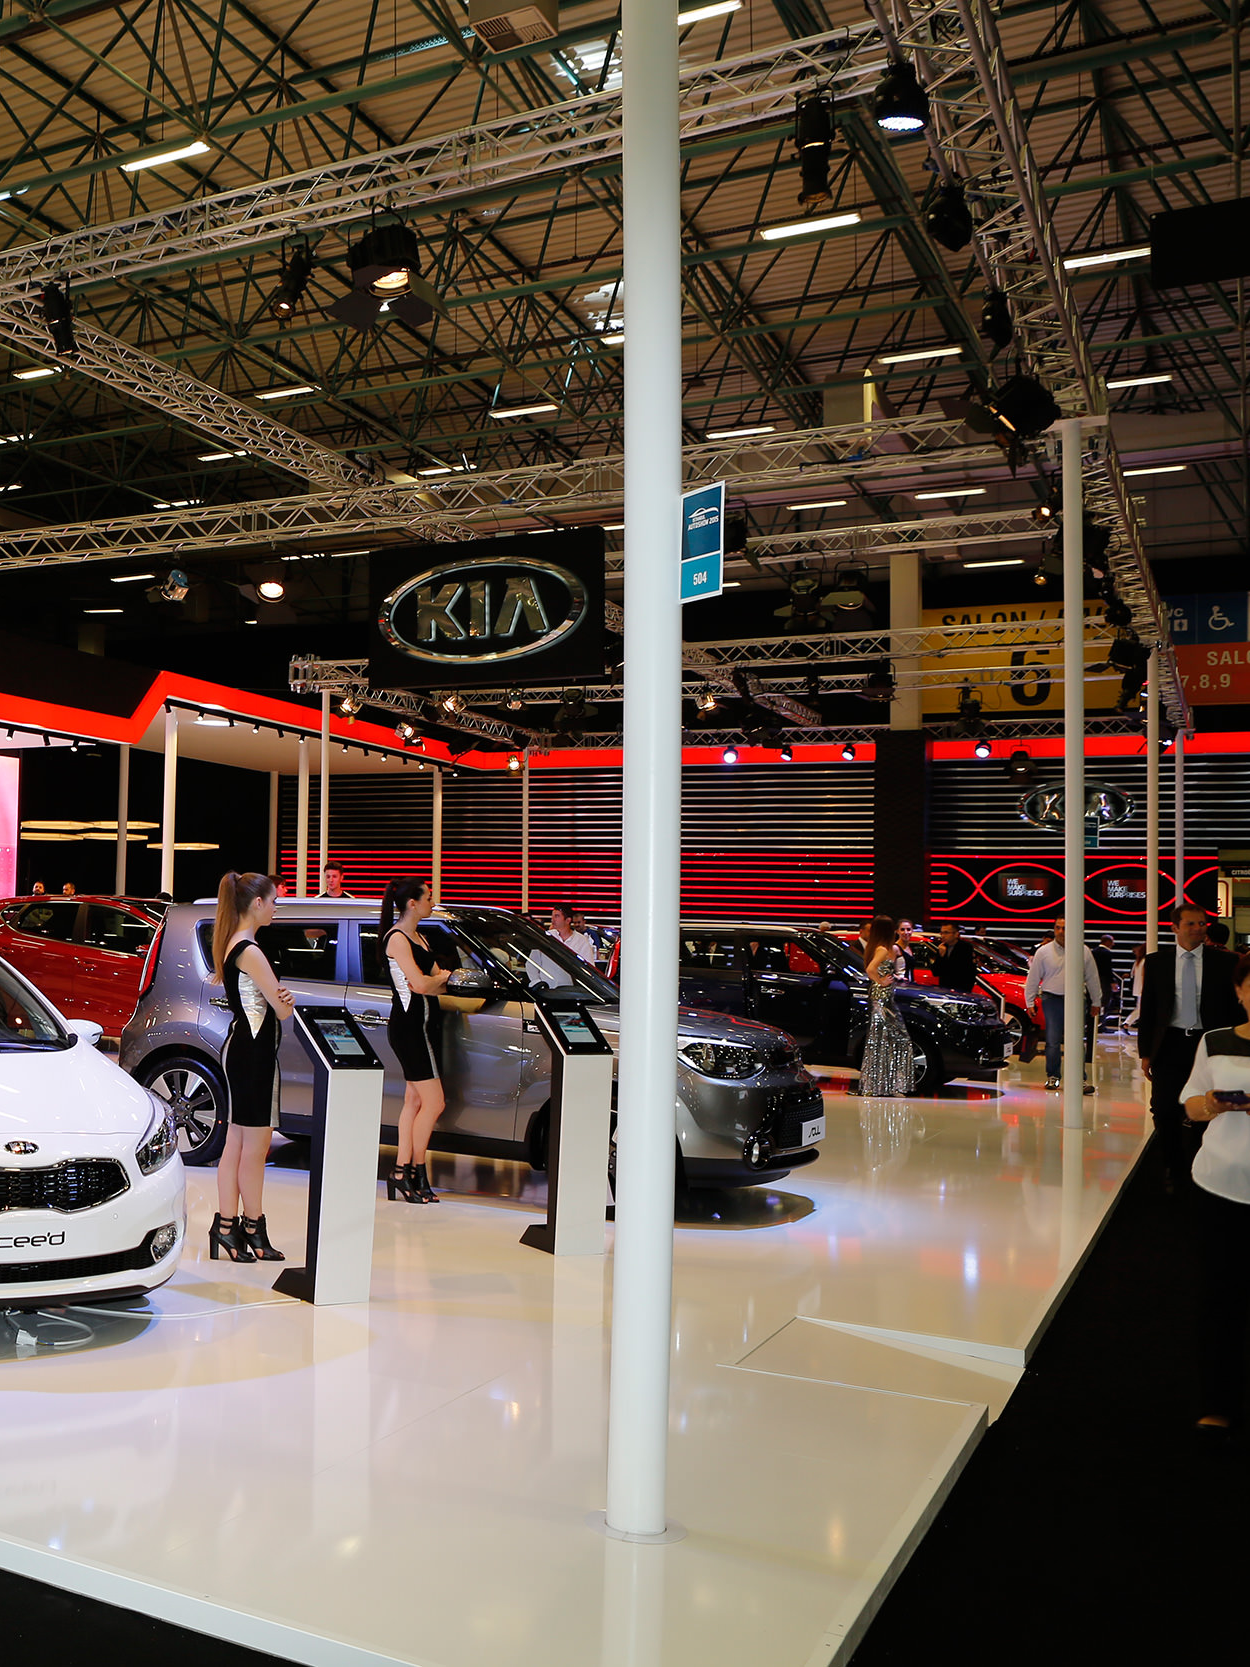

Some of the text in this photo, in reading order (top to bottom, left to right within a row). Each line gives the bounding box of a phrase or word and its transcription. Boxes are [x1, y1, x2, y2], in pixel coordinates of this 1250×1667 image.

[693, 571, 707, 586] 504
[415, 576, 550, 643] KIA
[1010, 641, 1051, 707] 6
[1037, 793, 1112, 820] KA
